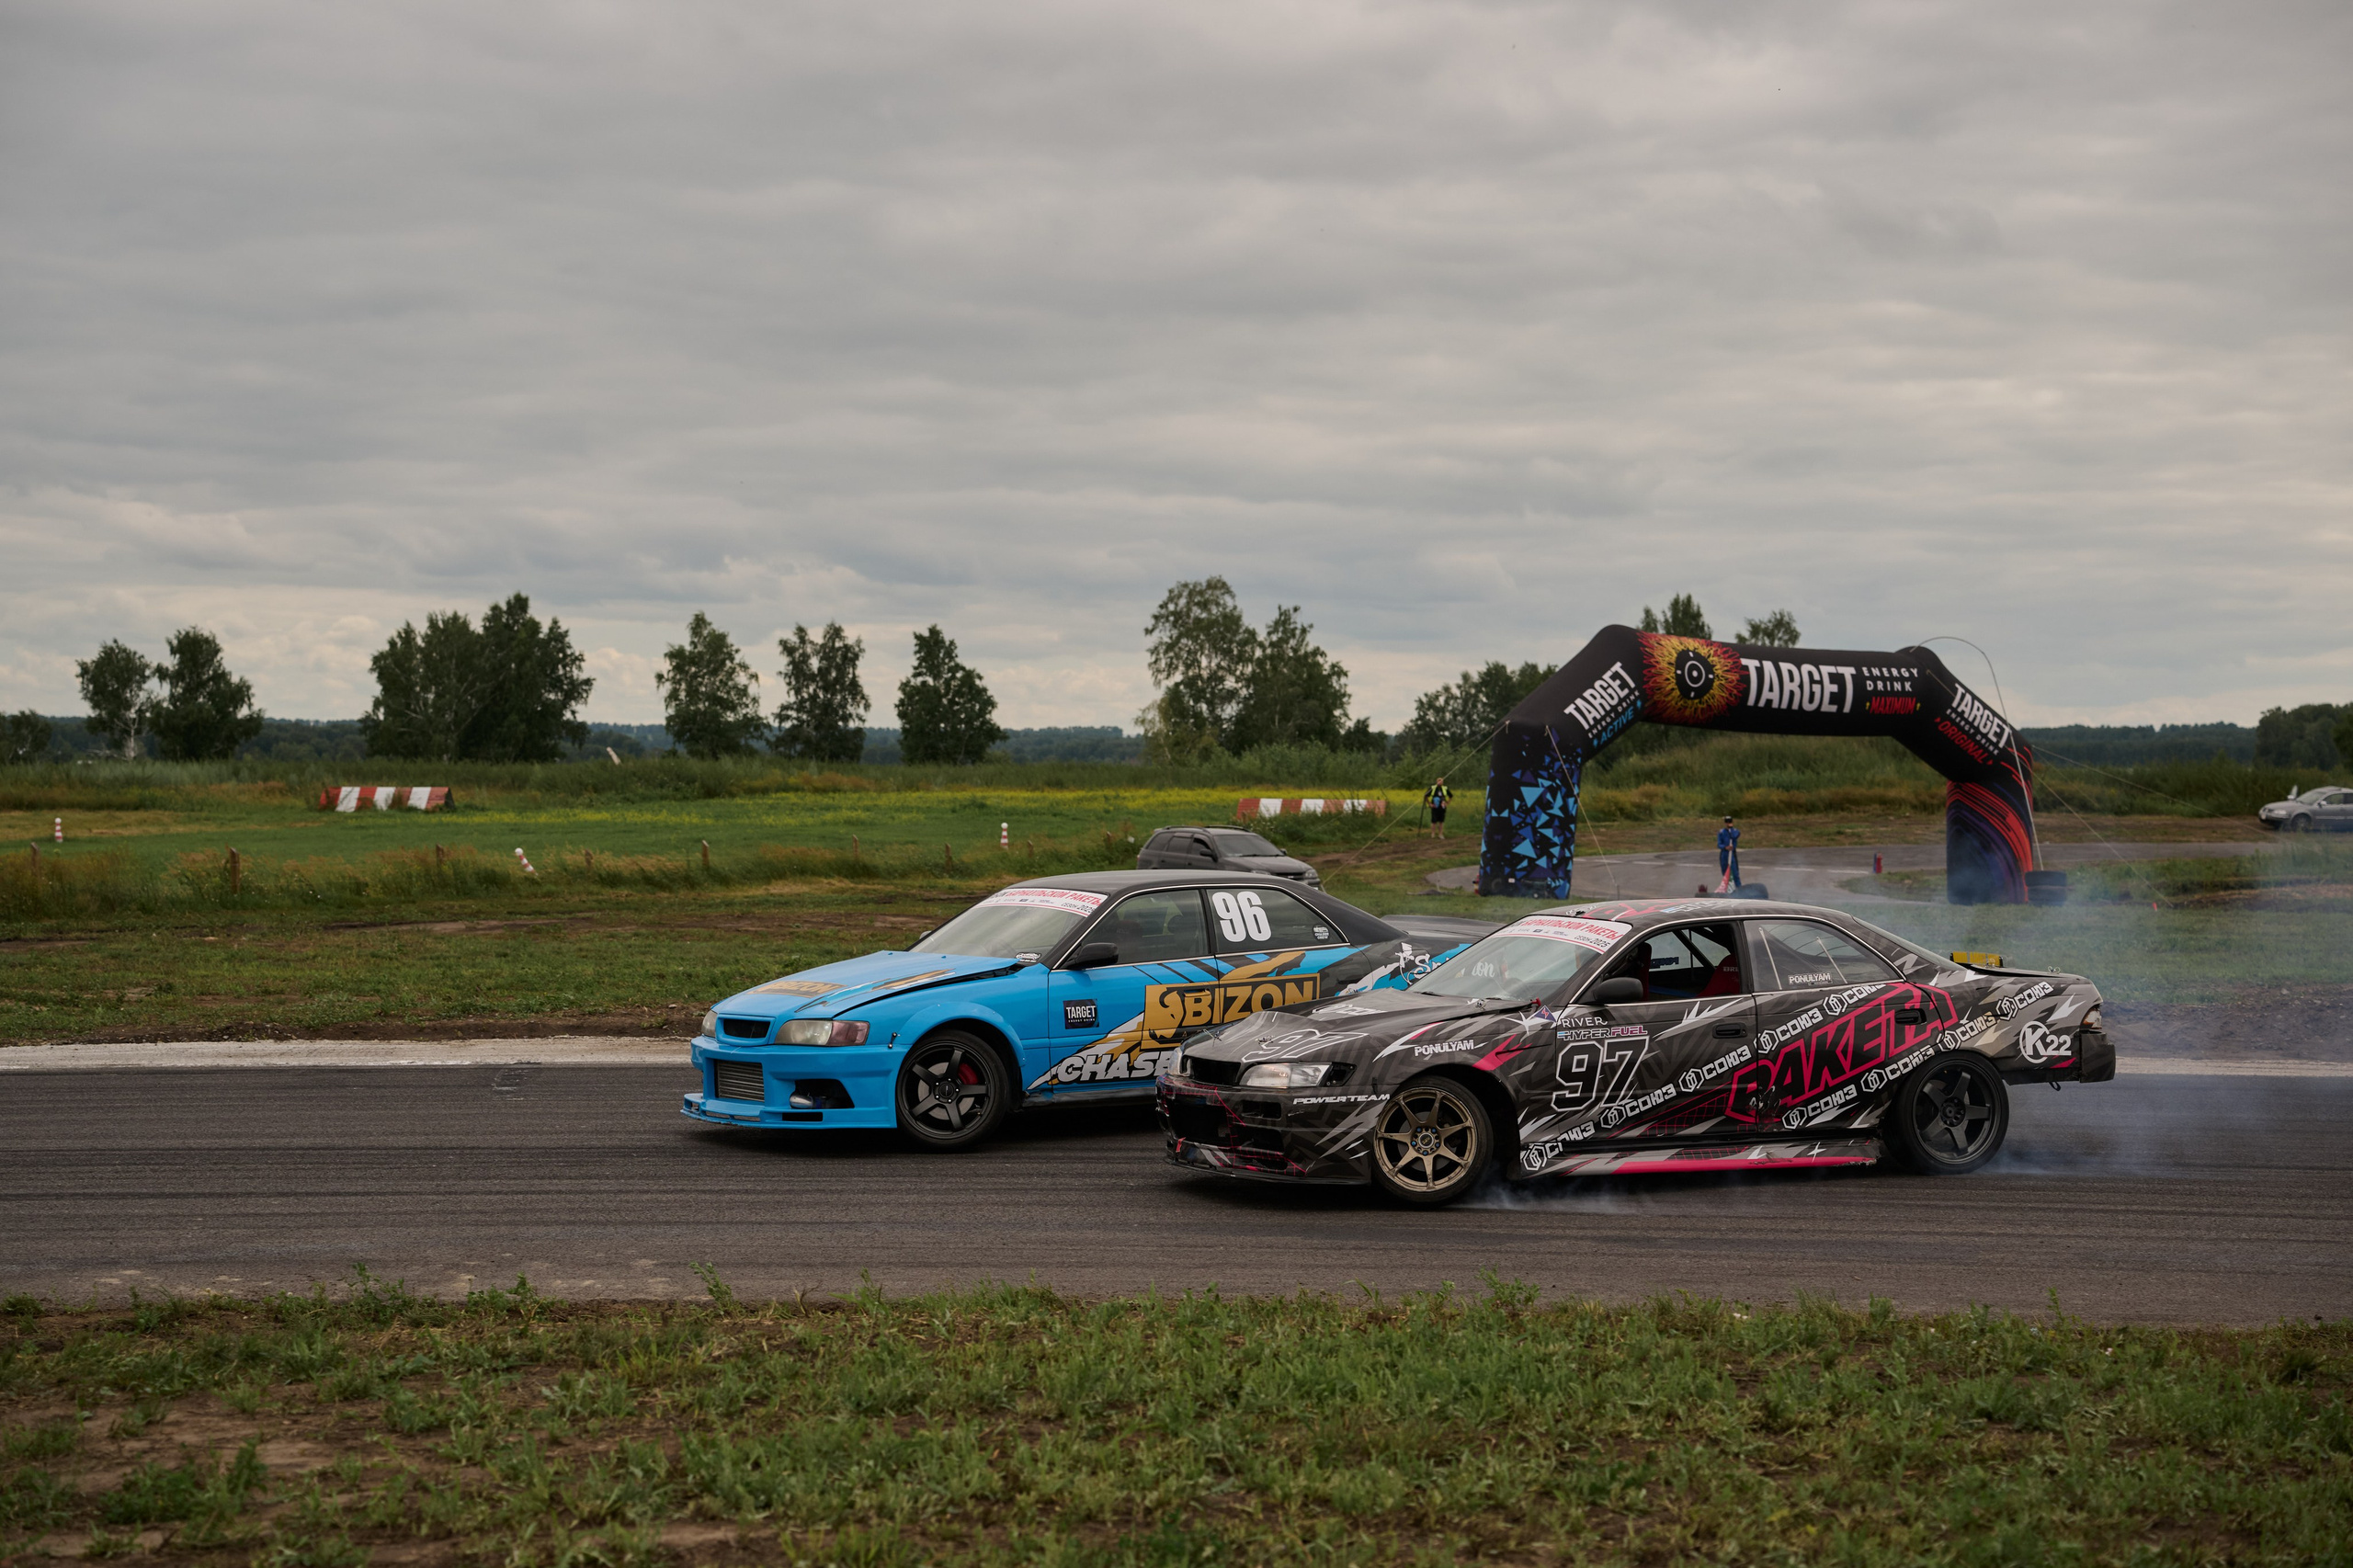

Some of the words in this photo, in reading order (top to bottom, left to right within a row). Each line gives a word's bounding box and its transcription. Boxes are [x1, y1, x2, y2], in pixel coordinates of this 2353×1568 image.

[1740, 657, 1857, 713] TARGET
[1862, 666, 1919, 677] ENERGY
[1866, 681, 1913, 691] DRINK
[1563, 662, 1635, 731] TARGET
[1870, 697, 1917, 715] MAXIMUM
[1588, 712, 1615, 738] ENERGY
[1618, 690, 1640, 712] DRINK
[1600, 706, 1634, 745] ACTIVE
[1951, 683, 2012, 748] TARGET
[1938, 721, 1988, 764] ORIGINAL
[1946, 709, 1974, 733] ENERGY
[1975, 734, 1999, 756] DRINK
[1212, 891, 1272, 942] 96
[1582, 924, 1624, 940] РАКЕТЫ
[1589, 938, 1611, 948] 2025
[1789, 972, 1832, 985] PONULYAM
[1182, 981, 1313, 1026] BIZON
[2014, 981, 2054, 1010] СОЮЗ
[1066, 1006, 1096, 1019] TARGET
[1563, 1017, 1608, 1028] RIVER
[1775, 1008, 1824, 1041] СОЮЗ
[1956, 1012, 1997, 1041] СОЮЗ
[1241, 1028, 1369, 1062] 97
[1415, 1040, 1474, 1056] PONULYAM
[1551, 1036, 1650, 1112] 97
[1702, 1045, 1752, 1080] СОЮЗ
[1626, 1084, 1677, 1117] СОЮЗ
[1808, 1085, 1858, 1117] СОЮЗ
